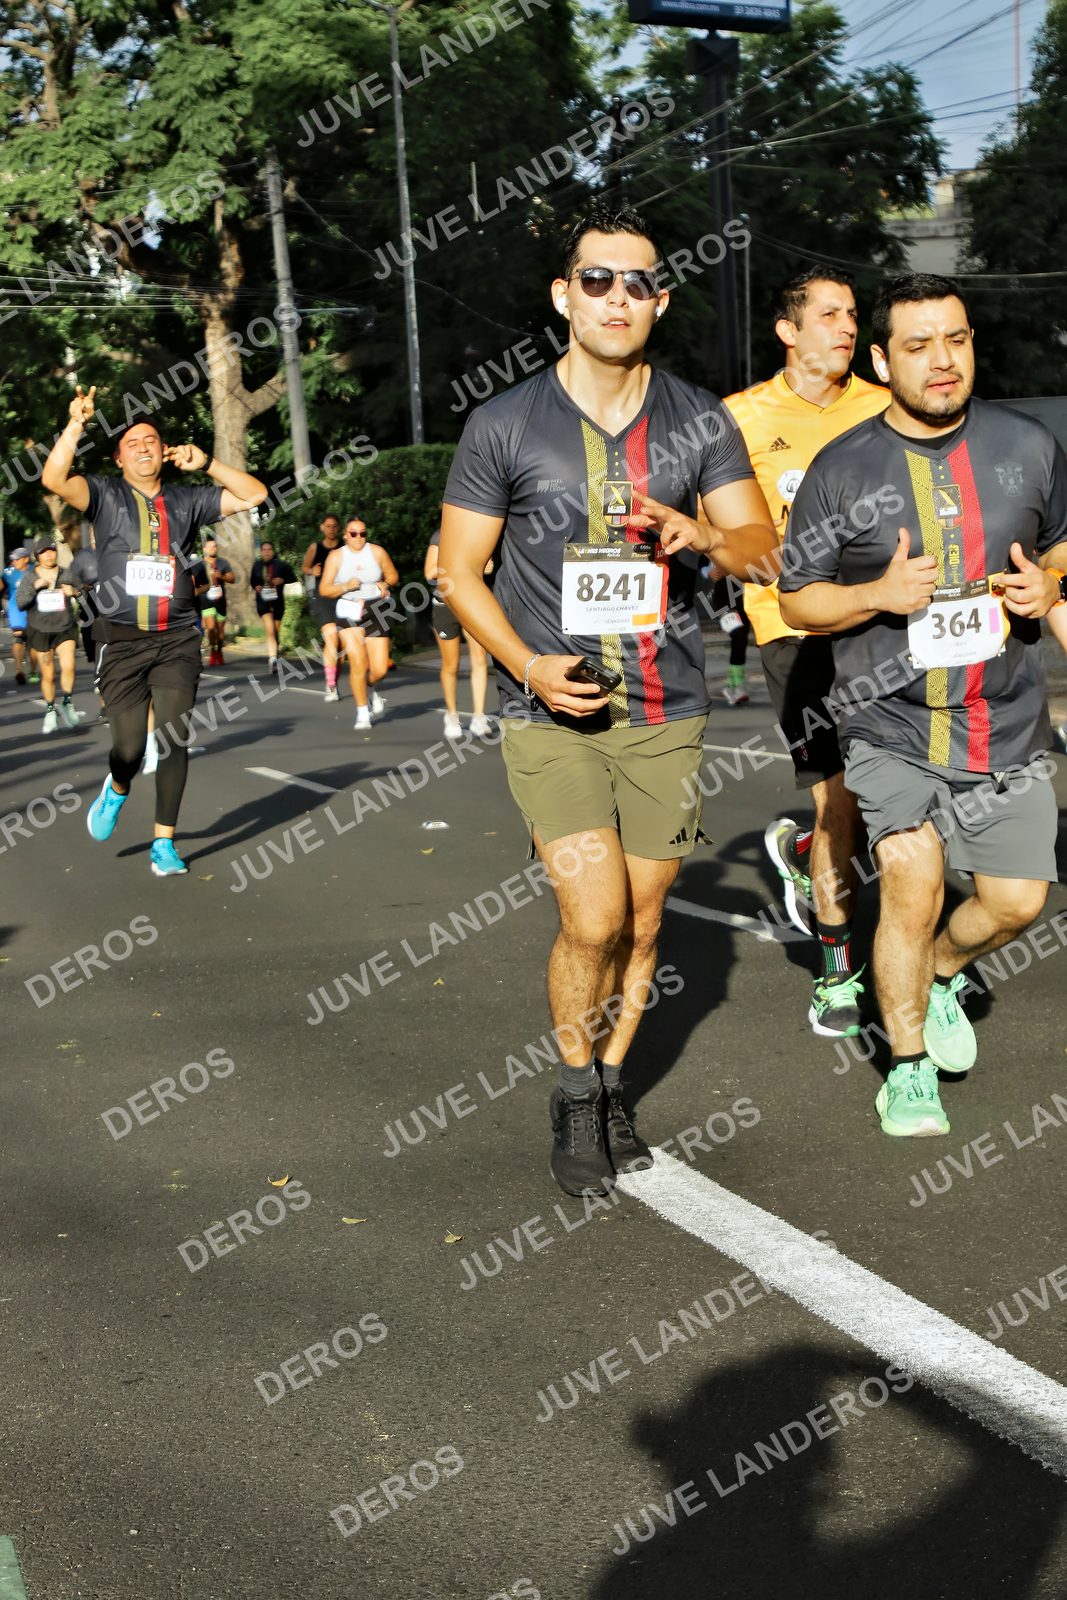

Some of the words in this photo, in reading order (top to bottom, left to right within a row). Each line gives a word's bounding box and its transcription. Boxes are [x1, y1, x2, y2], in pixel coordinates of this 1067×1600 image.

[131, 567, 171, 582] 10288
[576, 573, 646, 602] 8241
[931, 608, 982, 639] 364
